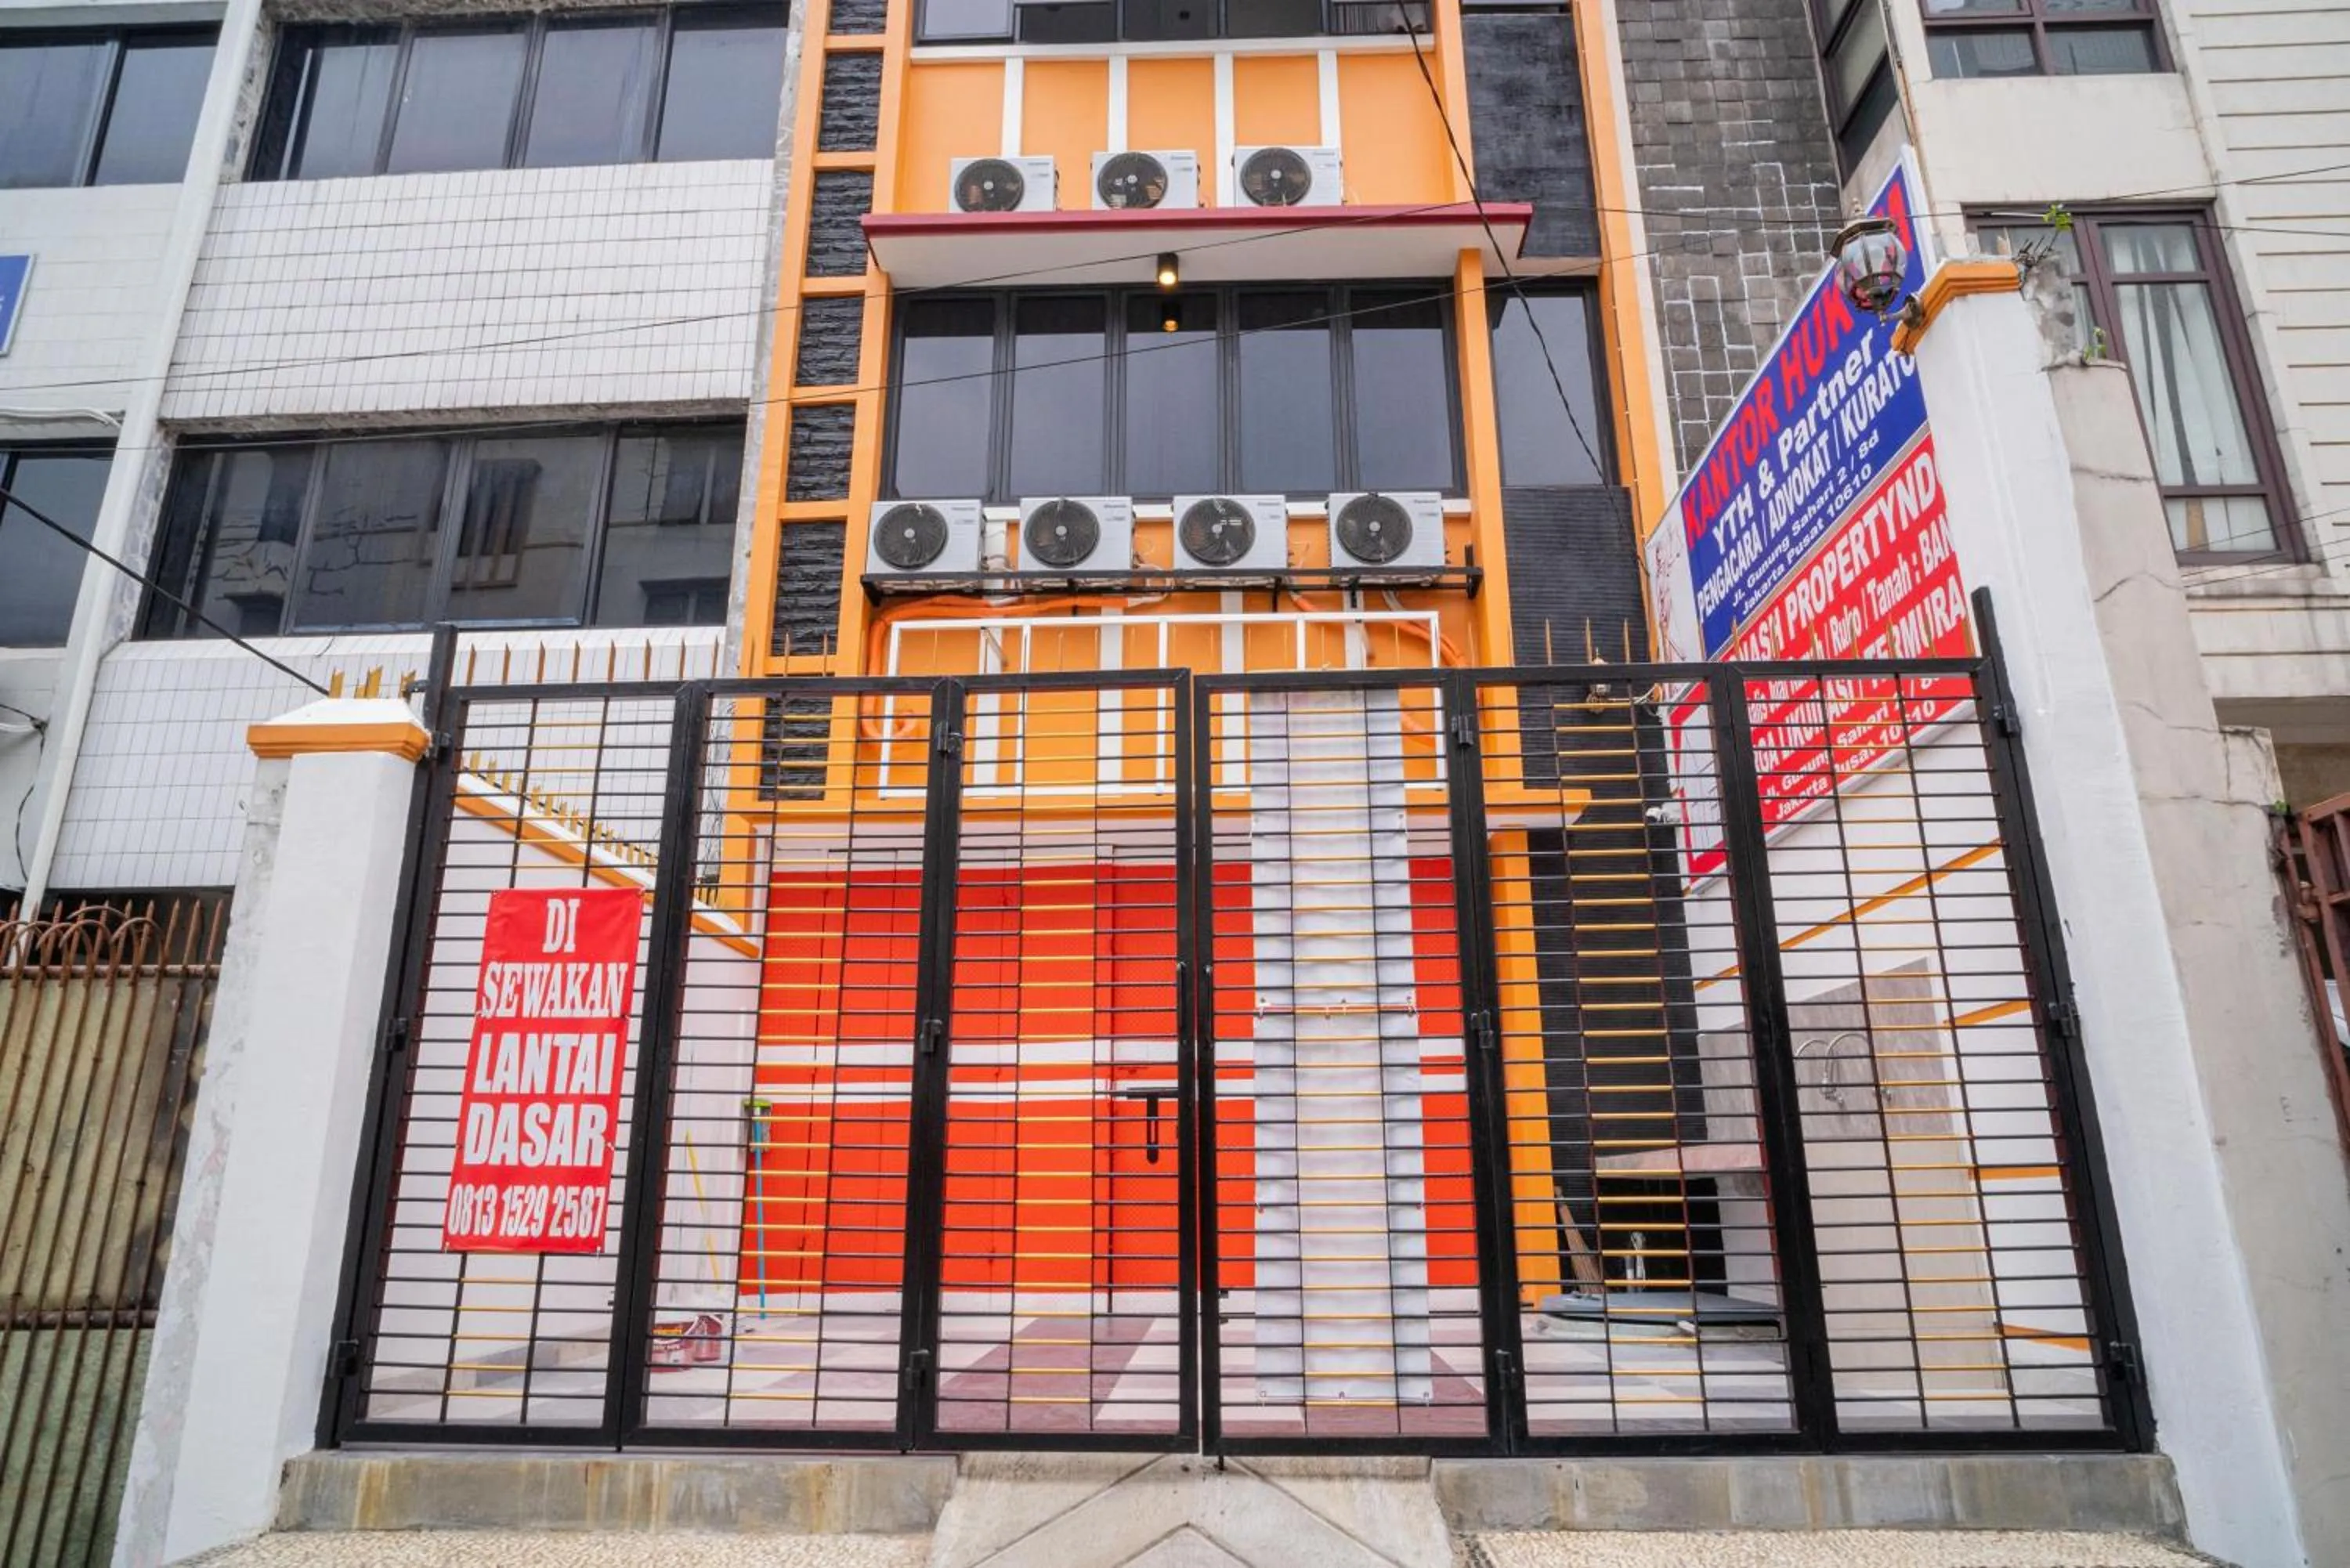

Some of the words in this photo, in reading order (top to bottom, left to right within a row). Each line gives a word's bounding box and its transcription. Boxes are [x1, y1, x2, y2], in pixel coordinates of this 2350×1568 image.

[1682, 378, 1780, 551] KANTOR
[1712, 482, 1754, 555] YTH
[1758, 458, 1776, 500] &
[1778, 327, 1874, 472] Partner
[1697, 522, 1762, 626] PENGACARA
[1768, 429, 1834, 539] ADVOKAT
[1743, 563, 1785, 616] Jakarta
[1786, 518, 1825, 565] Pusat
[1826, 463, 1872, 518] 10610
[1747, 537, 1790, 588] Gunung
[1791, 479, 1835, 536] Sahari
[1837, 466, 1848, 485] 2
[1857, 428, 1880, 460] 8d
[1784, 451, 1939, 641] PROPERTYND
[1867, 552, 1913, 621] Tanah
[542, 898, 580, 954] DI
[480, 962, 628, 1019] SEWAKAN
[472, 1033, 617, 1095] LANTAI
[463, 1102, 609, 1168] DASAR
[447, 1183, 498, 1237] 0813
[498, 1184, 549, 1238] 1529
[548, 1185, 606, 1239] 2587
